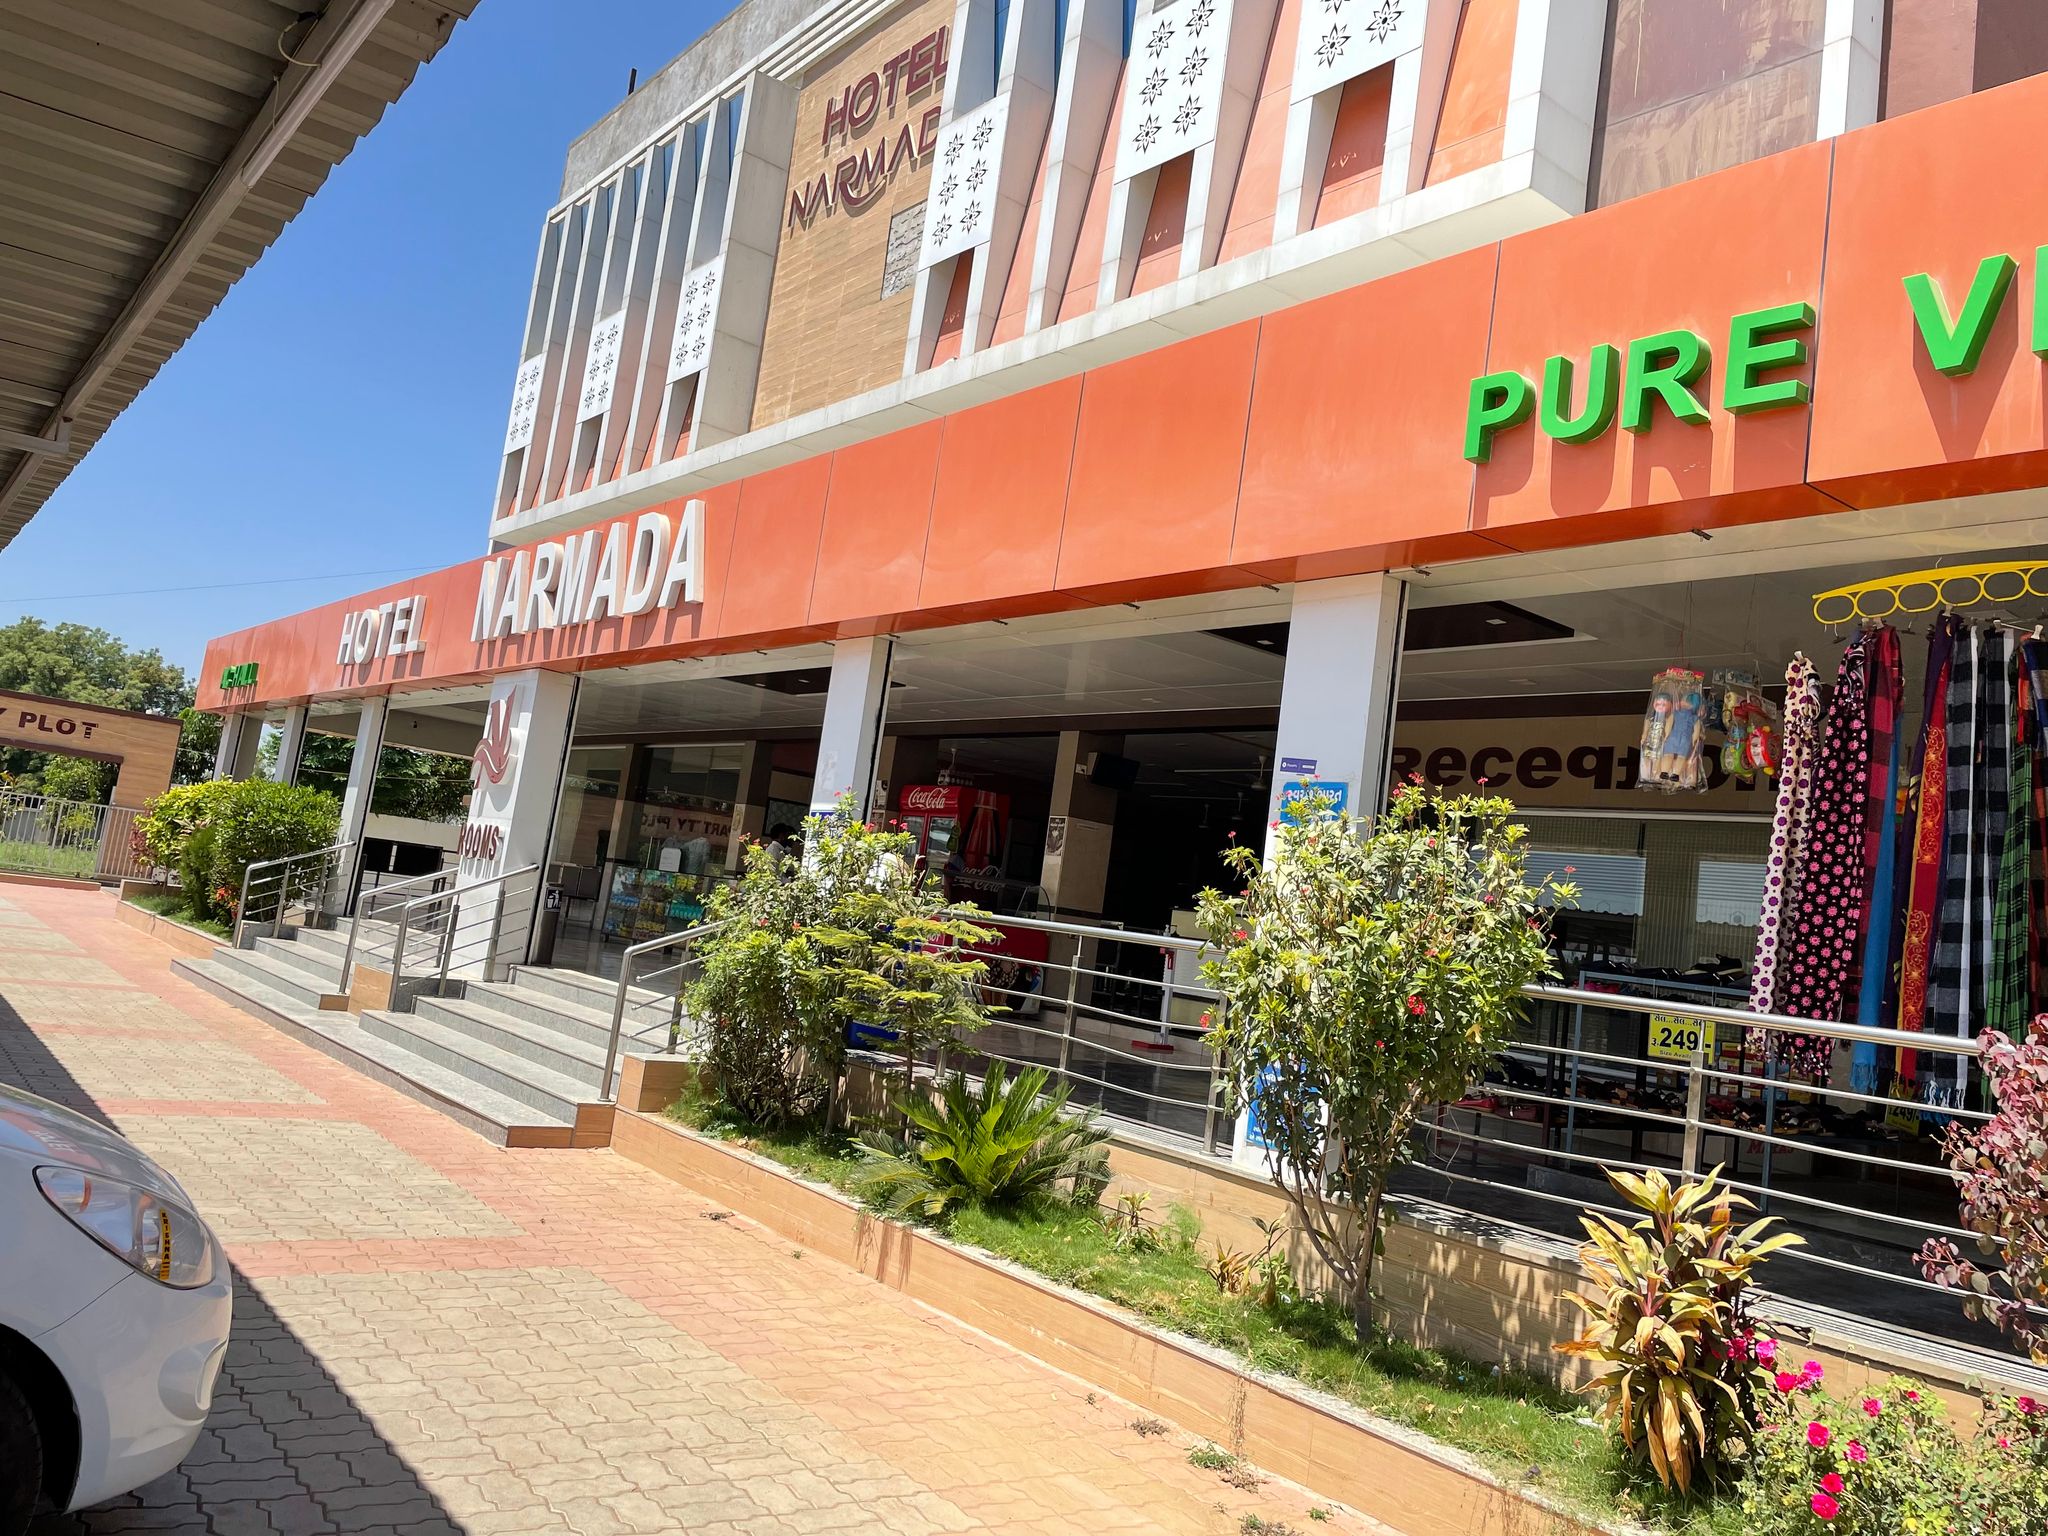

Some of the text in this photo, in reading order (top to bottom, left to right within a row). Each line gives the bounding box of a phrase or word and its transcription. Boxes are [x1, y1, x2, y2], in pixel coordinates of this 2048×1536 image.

[822, 25, 948, 146] HOTEL
[1463, 245, 2048, 464] PURE V
[337, 499, 706, 664] HOTEL NARMADA
[18, 711, 98, 739] PLOT
[457, 823, 500, 860] ROOMS
[161, 1212, 170, 1260] KRISHNA
